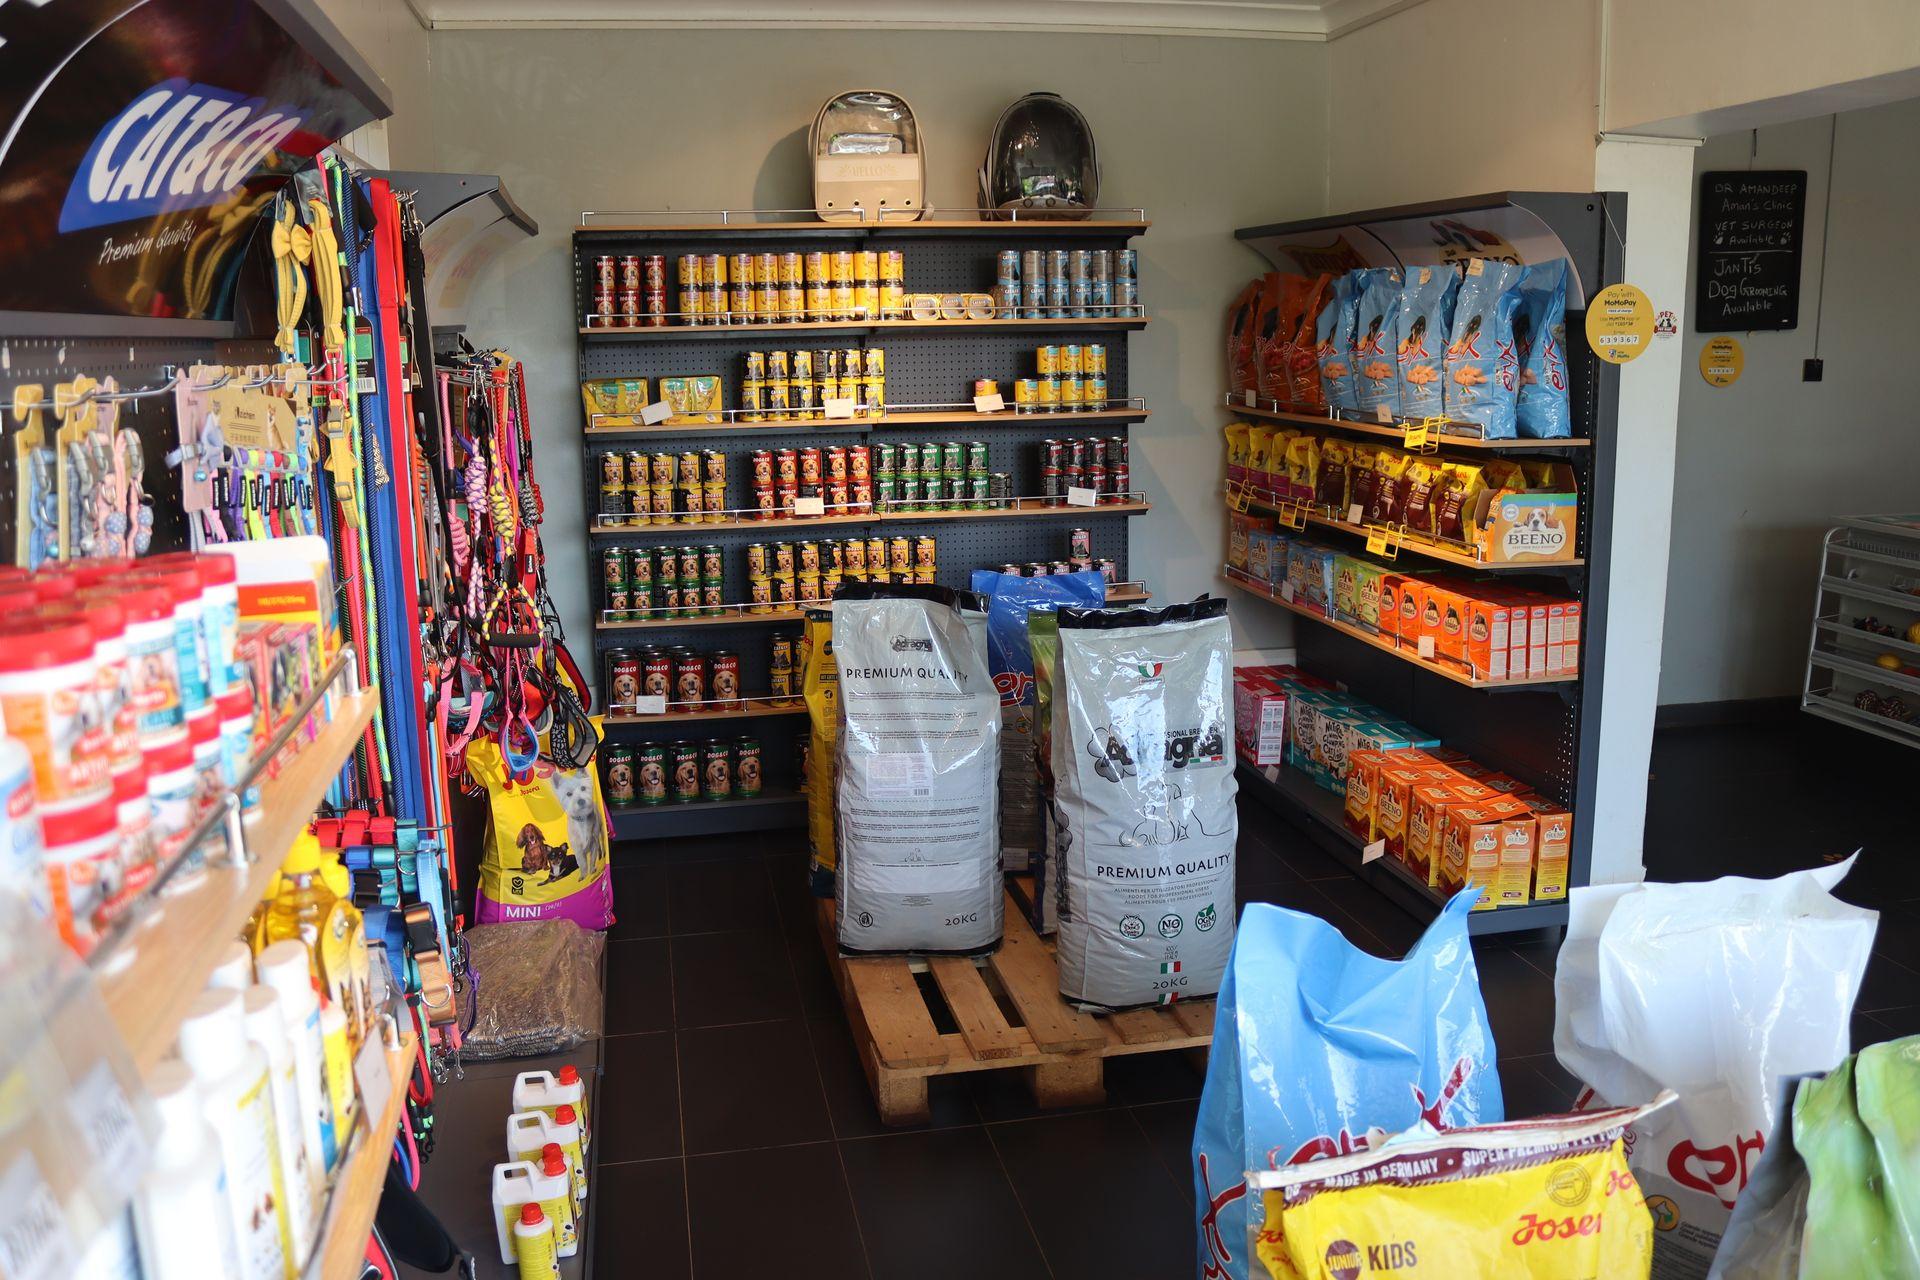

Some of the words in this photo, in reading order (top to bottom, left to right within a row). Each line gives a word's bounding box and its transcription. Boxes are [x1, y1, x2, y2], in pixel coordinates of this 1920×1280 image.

[88, 91, 300, 203] CAT&CO
[1763, 200, 1792, 210] Clinic
[1715, 221, 1736, 231] VET
[1742, 220, 1792, 230] SURGEON
[99, 233, 153, 264] Premium
[156, 220, 197, 251] Quality
[1730, 235, 1774, 246] Available
[1709, 280, 1736, 299] Dog
[1722, 300, 1772, 316] Available
[1508, 533, 1563, 544] BEENO
[846, 668, 912, 679] PREMIUM
[677, 753, 698, 761] DOG&CO
[708, 751, 728, 759] DOG&CO
[740, 748, 760, 756] DOG&CO
[610, 755, 632, 763] DOG&CO
[1348, 782, 1368, 799] BEENO
[1380, 798, 1402, 816] BEENO
[1445, 841, 1464, 861] BEENO
[1098, 866, 1171, 878] PREMIUM
[1176, 852, 1230, 874] QUALITY
[506, 906, 540, 918] MINI
[945, 913, 977, 926] 20KG
[1162, 919, 1180, 930] NO
[1153, 977, 1188, 989] 20KG
[1325, 1174, 1360, 1188] MADE
[1364, 1171, 1378, 1182] IN
[1380, 1158, 1438, 1179] GERMANY
[1462, 1150, 1505, 1167] SUPER
[1367, 1241, 1417, 1271] KIDS
[1326, 1254, 1362, 1272] JUNIOR
